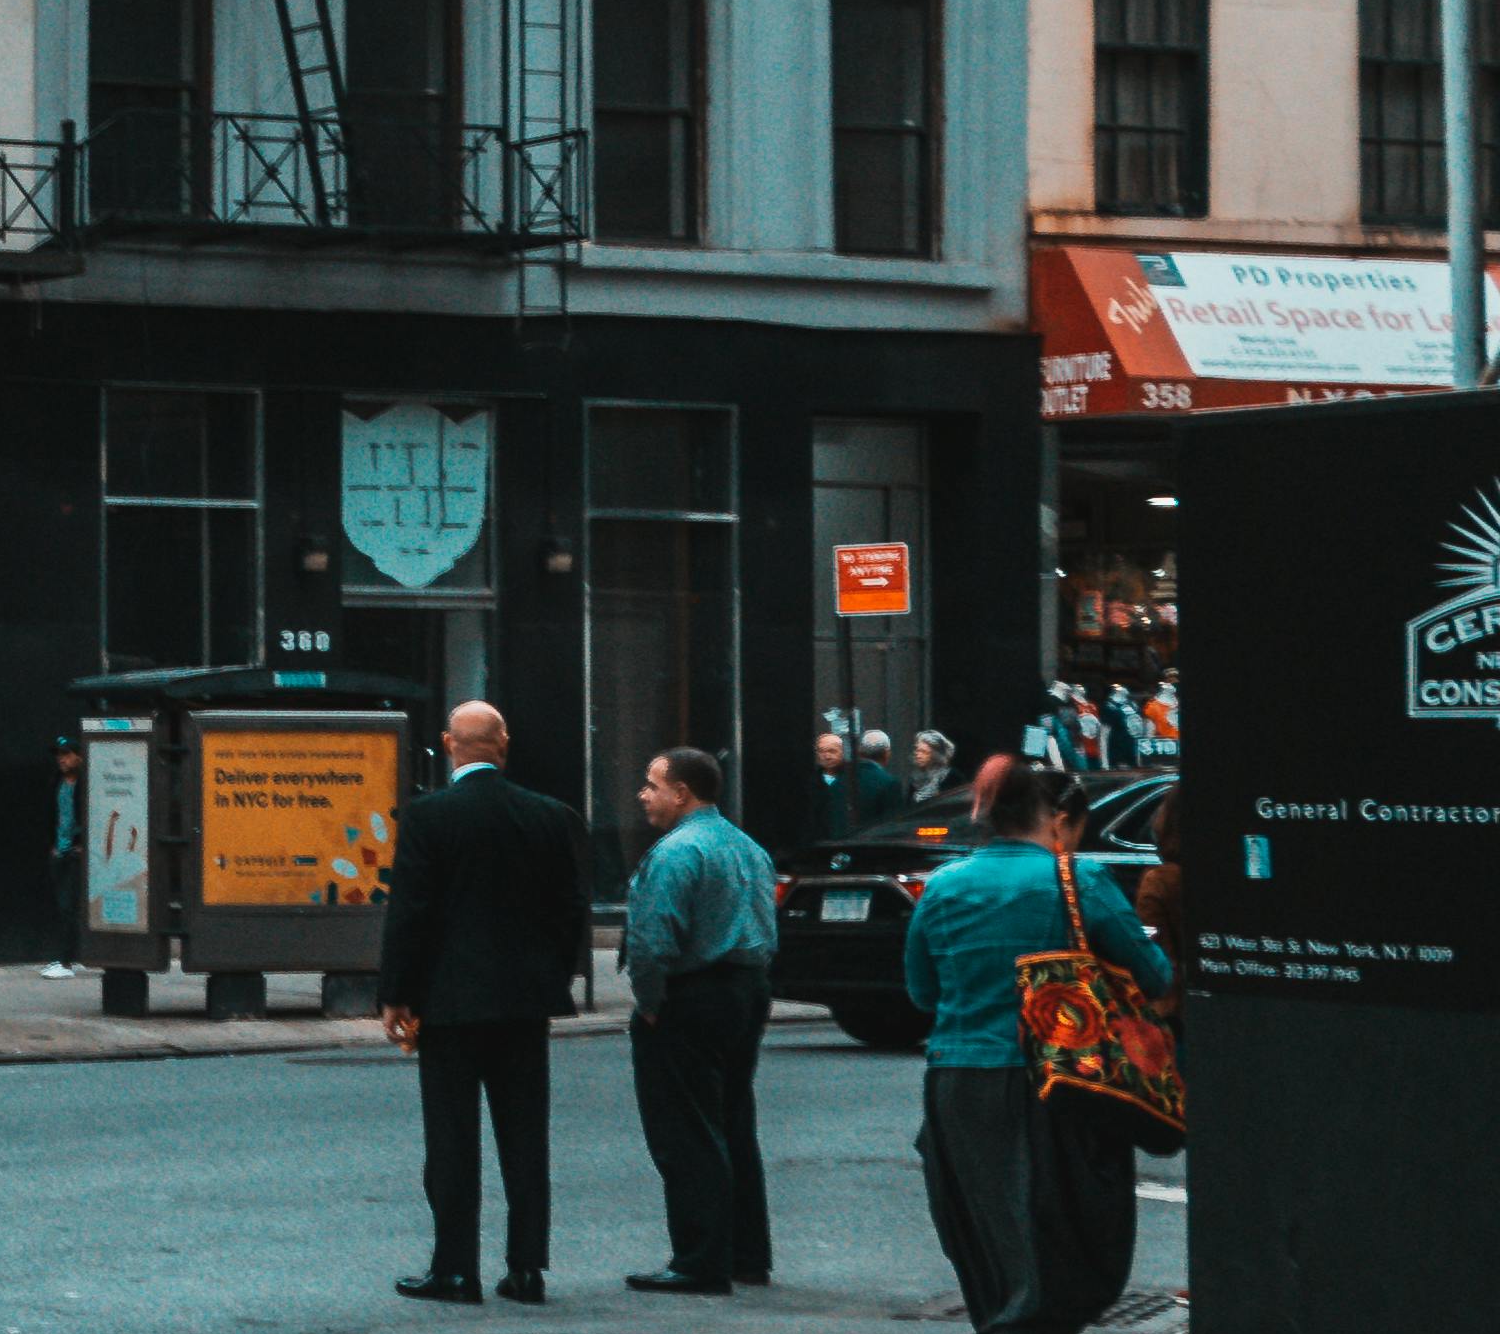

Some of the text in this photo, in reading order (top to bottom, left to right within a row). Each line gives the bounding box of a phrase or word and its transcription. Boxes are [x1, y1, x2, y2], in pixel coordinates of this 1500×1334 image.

[1231, 263, 1418, 294] PD Properties
[1164, 296, 1263, 326] Retail
[1267, 300, 1364, 334] Space
[1367, 302, 1415, 331] for
[1141, 382, 1193, 410] 358
[841, 553, 856, 564] NO
[215, 768, 364, 788] Deliver everywhere
[215, 790, 230, 808] in
[233, 791, 269, 808] NYC
[272, 790, 295, 809] for
[1255, 797, 1348, 819] General
[1306, 938, 1339, 956] New
[1199, 957, 1231, 974] Main
